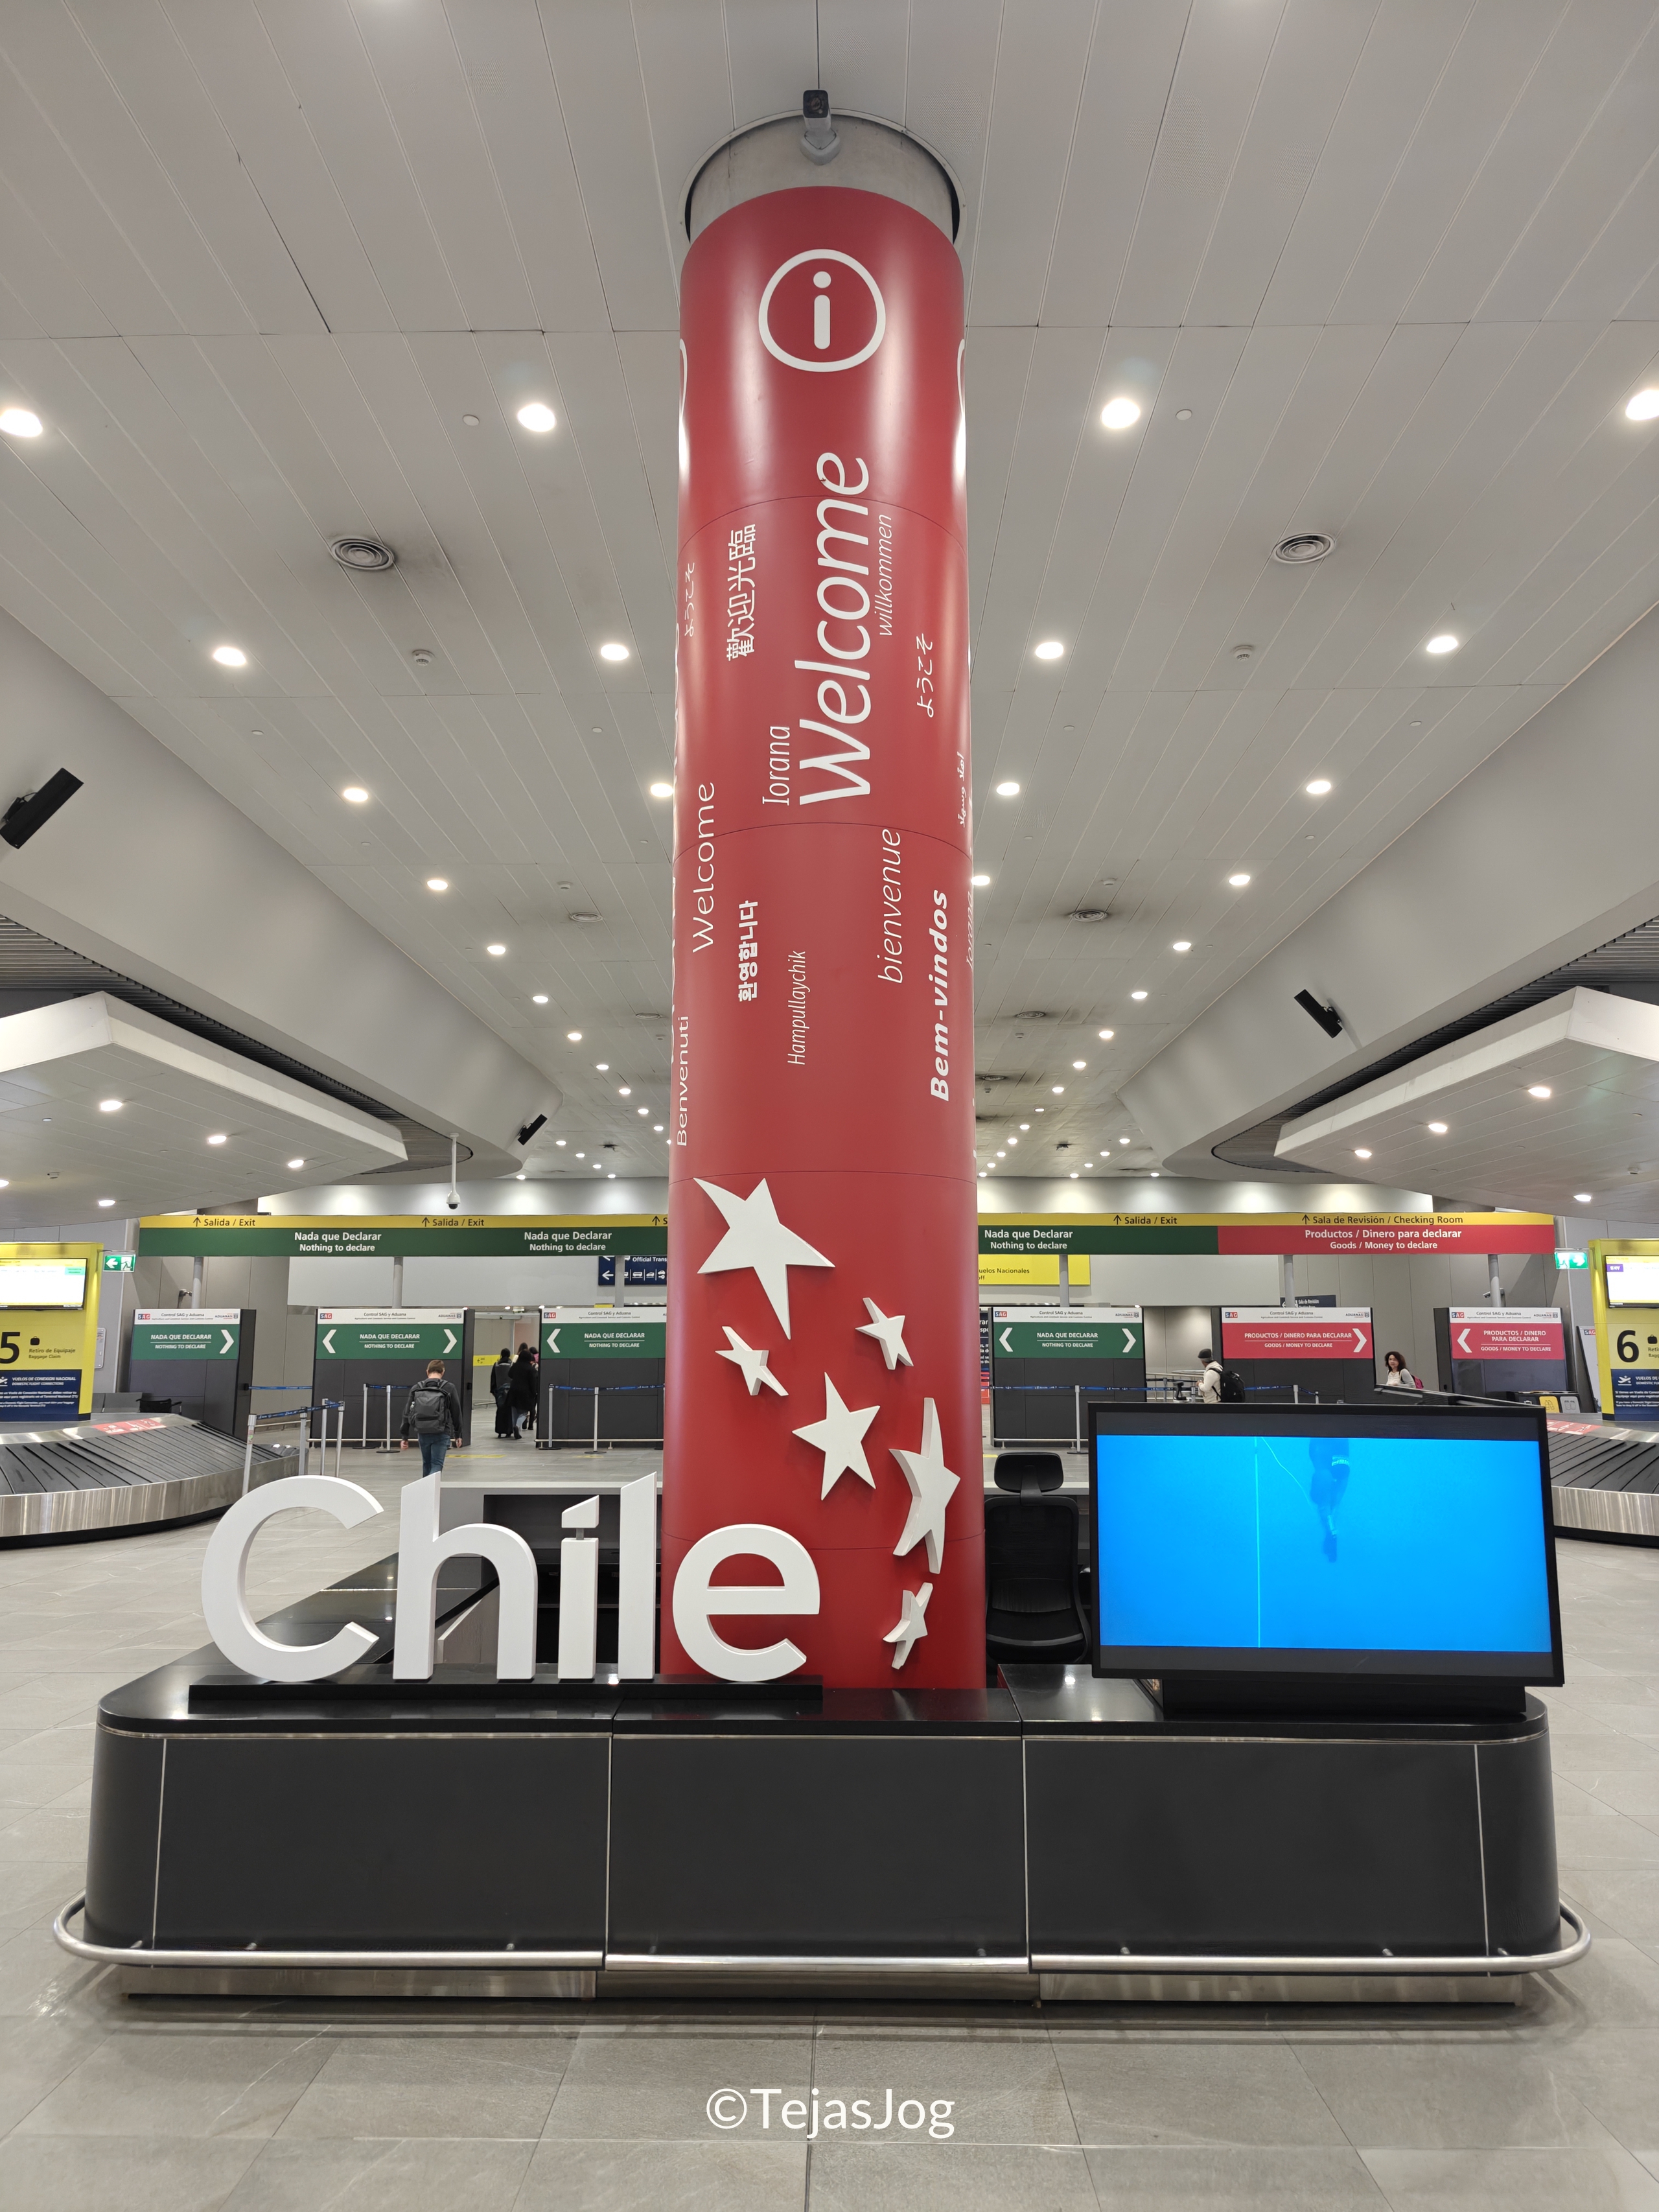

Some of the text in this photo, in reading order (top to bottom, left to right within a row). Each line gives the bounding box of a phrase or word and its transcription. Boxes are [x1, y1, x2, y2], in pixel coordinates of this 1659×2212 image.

[684, 562, 695, 637] ようこそ
[726, 523, 756, 662] 歡迎光臨
[874, 514, 892, 636] willkommen
[795, 452, 872, 806] Welcome
[916, 633, 934, 718] ようこそ
[762, 725, 791, 806] Iorana
[692, 782, 715, 954] Welcome
[877, 828, 903, 984] bienvenue
[738, 900, 758, 1002] 환영합니다
[787, 950, 811, 1065] Hampullaychik
[930, 889, 949, 1102] Bem-vindos
[677, 1015, 689, 1147] Benvenuti
[294, 1231, 382, 1242] Nada que Declarar
[299, 1244, 332, 1253] Nothing
[524, 1231, 549, 1240] Nada
[573, 1231, 612, 1240] Declarar
[529, 1244, 563, 1252] Nothing
[984, 1229, 1009, 1239] Nada
[1033, 1229, 1073, 1239] Declarar
[990, 1242, 1024, 1250] Nothing
[1305, 1229, 1352, 1239] Productos
[1362, 1229, 1395, 1238] Dinero
[1398, 1231, 1420, 1240] para
[1422, 1229, 1461, 1238] declarar
[1347, 1215, 1384, 1224] Revisión
[1394, 1216, 1434, 1225] Checking
[1365, 1242, 1393, 1251] Money
[0, 1332, 20, 1364] 5
[1617, 1330, 1639, 1362] 6
[201, 1471, 820, 1682] Chile
